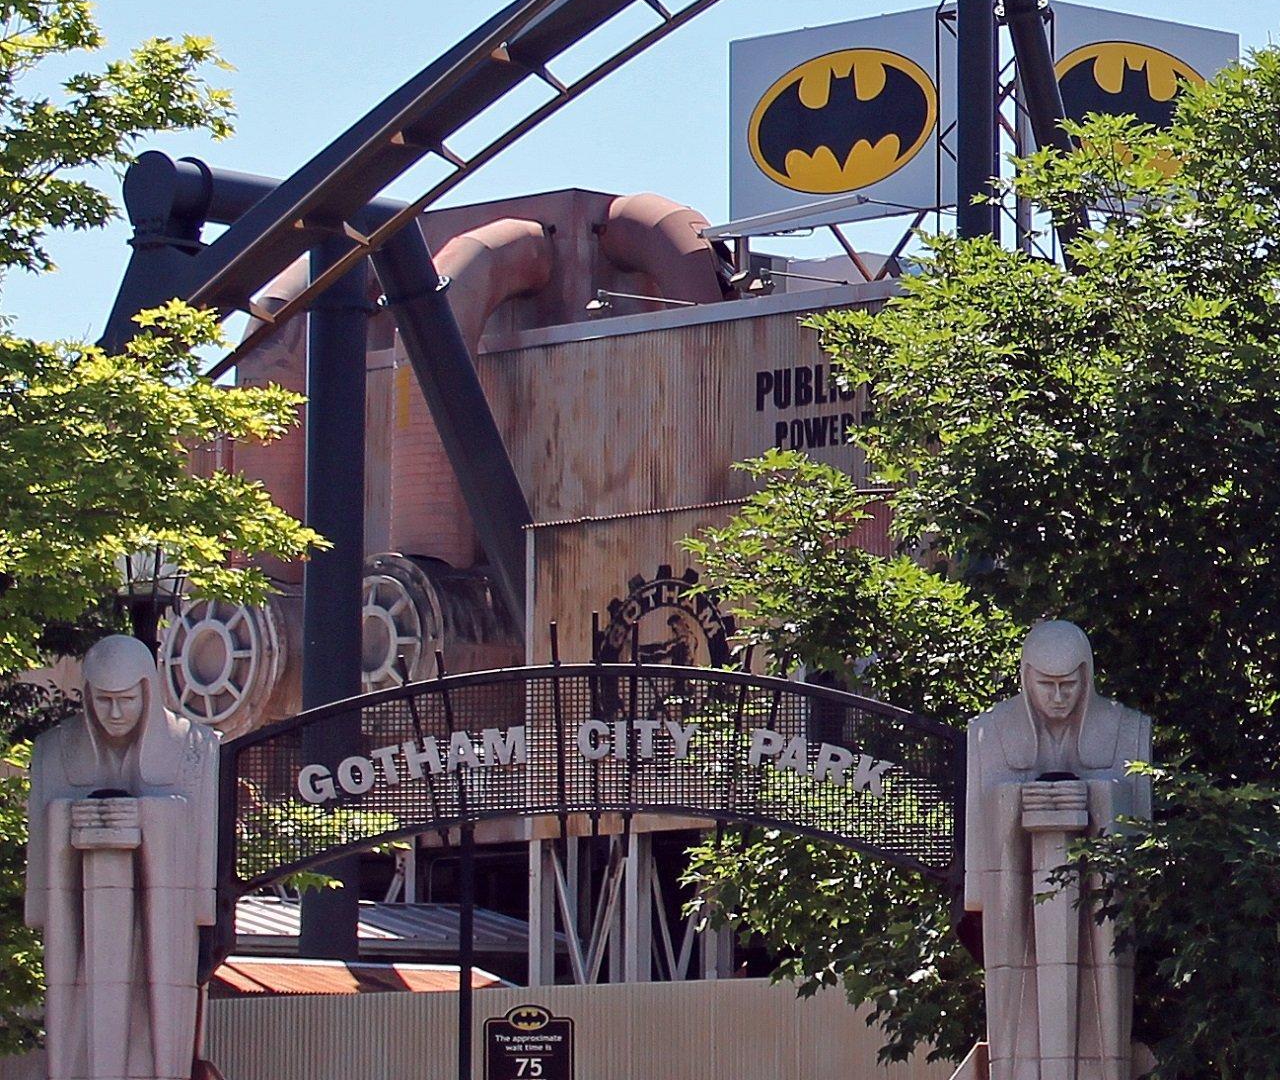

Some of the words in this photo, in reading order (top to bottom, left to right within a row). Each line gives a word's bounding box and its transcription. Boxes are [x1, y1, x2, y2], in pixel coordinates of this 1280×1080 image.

[774, 413, 855, 451] POWER
[298, 725, 527, 804] GOTHAM
[577, 720, 700, 760] CITY
[749, 727, 895, 799] PARK
[512, 1035, 562, 1043] approximate
[515, 1057, 543, 1077] 75
